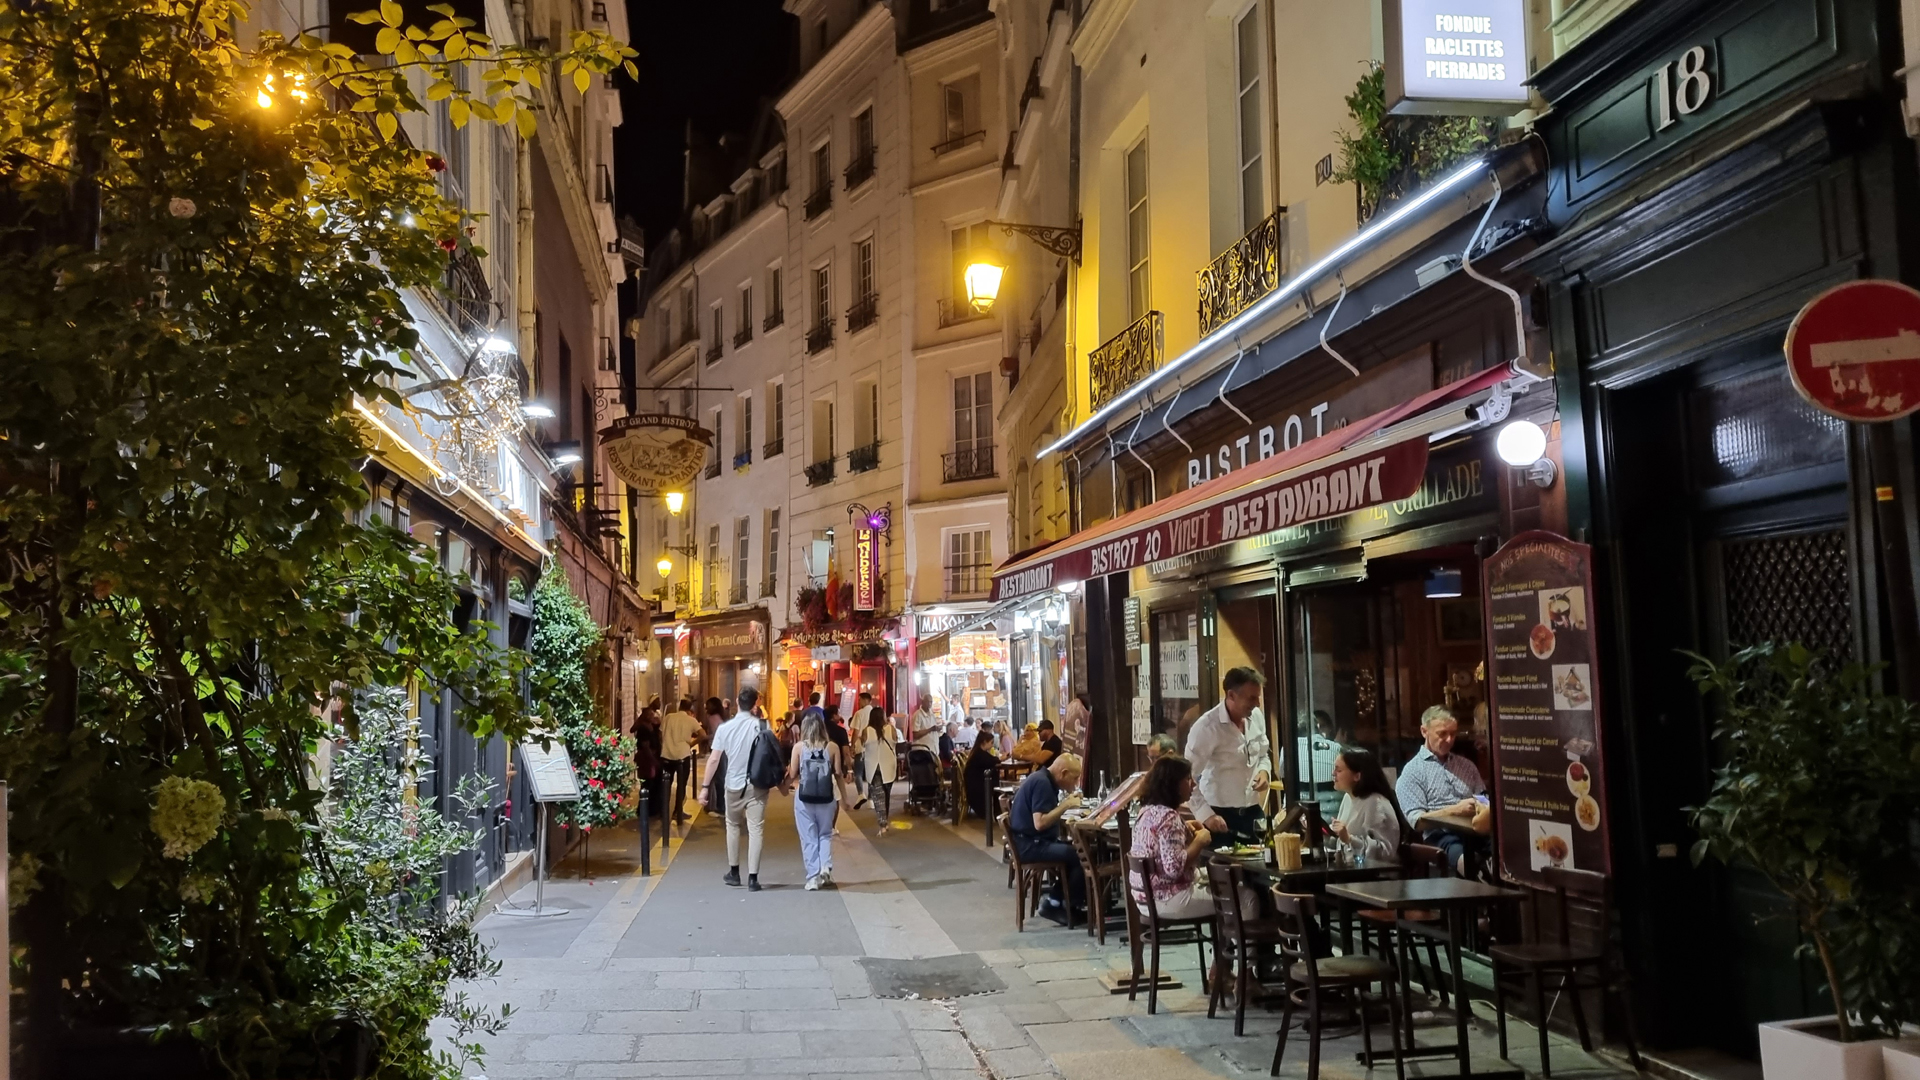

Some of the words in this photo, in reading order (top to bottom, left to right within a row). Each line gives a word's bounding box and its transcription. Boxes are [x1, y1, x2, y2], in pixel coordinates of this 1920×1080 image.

[1435, 14, 1492, 34] FONDUE
[1425, 37, 1504, 58] RACLETTES
[1426, 60, 1506, 81] PIERRADES
[1653, 46, 1710, 132] 18
[615, 420, 627, 429] LE
[629, 416, 659, 426] GRAND
[661, 416, 697, 429] BISTROT
[1188, 401, 1329, 489] BISTROT
[607, 446, 656, 488] RESTAURANT
[669, 444, 706, 484] TRADITION
[1000, 563, 1053, 597] RESTAURANT
[1091, 536, 1139, 575] BISTROT
[1144, 529, 1161, 563] 20
[1168, 510, 1211, 556] Vingt
[1222, 456, 1386, 542] RESTAURANT
